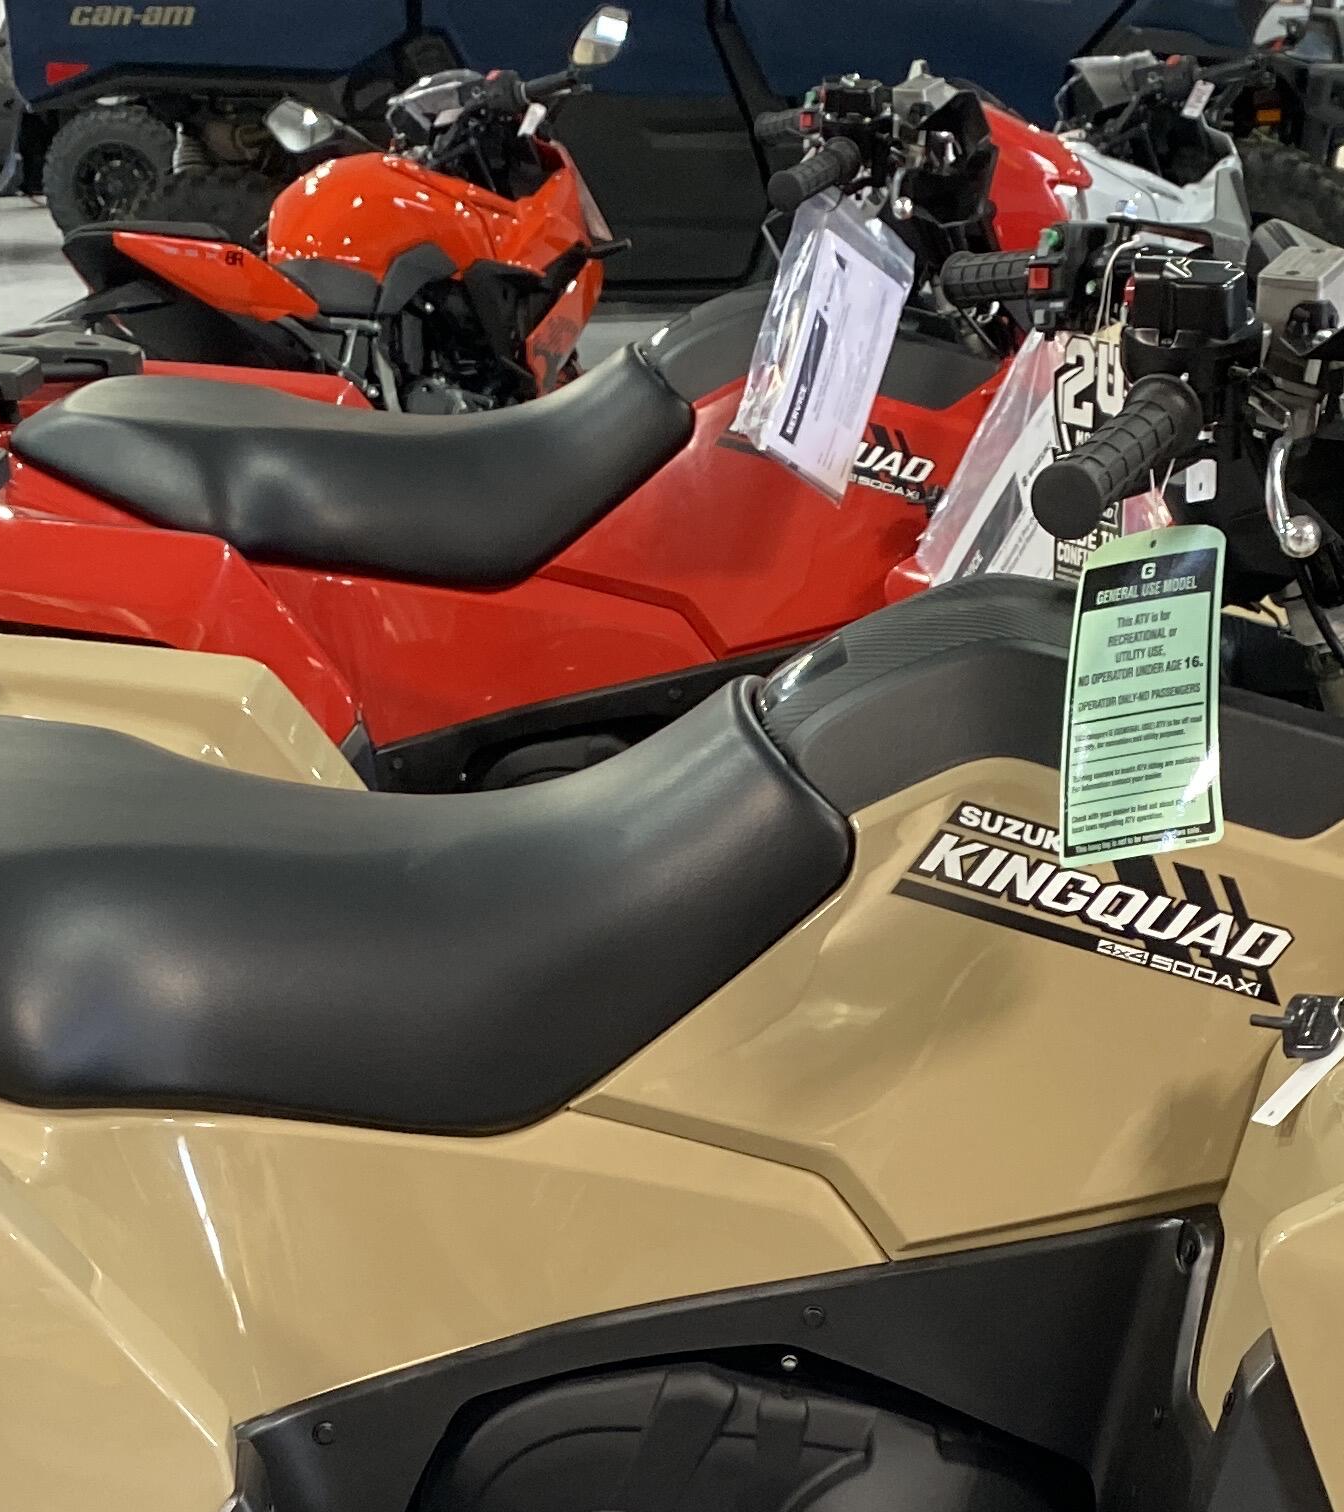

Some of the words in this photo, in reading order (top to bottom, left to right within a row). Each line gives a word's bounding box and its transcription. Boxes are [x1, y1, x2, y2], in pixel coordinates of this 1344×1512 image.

[69, 5, 196, 26] can-am
[786, 384, 808, 436] SERVICE
[1141, 562, 1156, 580] G
[1096, 584, 1139, 605] GENERAL
[1141, 580, 1161, 598] USE
[1163, 575, 1198, 594] MODEL
[1117, 616, 1133, 628] This
[1134, 613, 1151, 625] ATV
[1160, 610, 1172, 620] for
[1107, 629, 1167, 648] RECREATIONAL
[1115, 648, 1146, 663] UTILITY
[1078, 675, 1090, 687] NO
[1091, 667, 1134, 685] OPERATOR
[1135, 661, 1164, 677] UNDER
[1165, 659, 1183, 673] AGE
[1077, 696, 1117, 713] OPERATOR
[1151, 682, 1201, 699] PASSENGERS
[958, 804, 1062, 853] SUZUK
[919, 832, 1295, 968] KINGQUAD
[1099, 943, 1146, 963] 4x4
